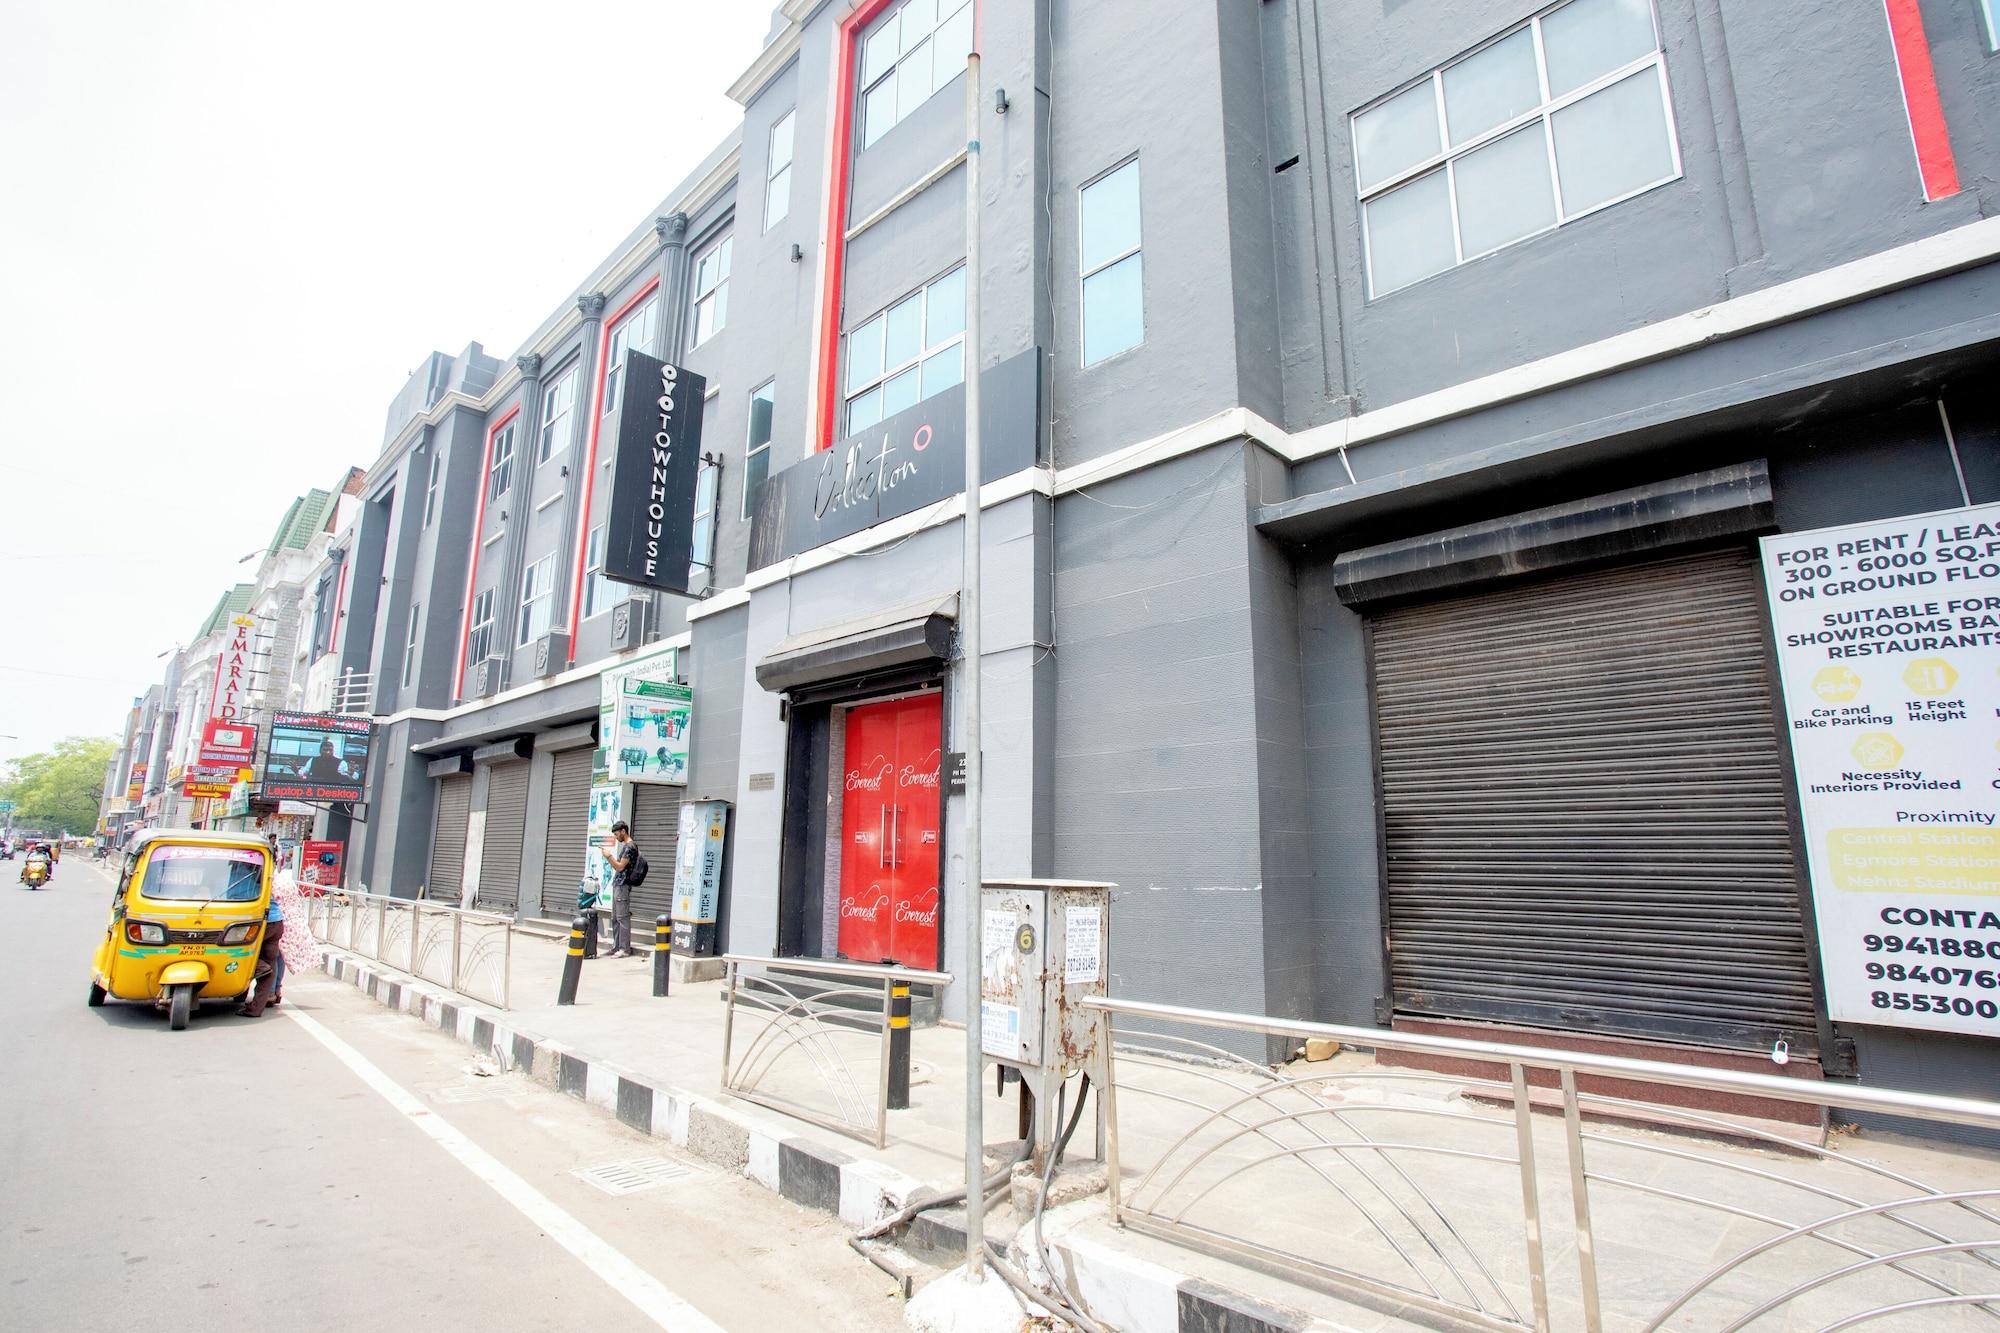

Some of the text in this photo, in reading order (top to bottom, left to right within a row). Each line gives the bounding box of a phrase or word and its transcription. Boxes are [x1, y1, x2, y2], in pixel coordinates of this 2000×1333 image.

[645, 364, 678, 577] OYO TOWNHOUSE
[814, 433, 917, 520] Collection
[1776, 546, 1829, 566] FOR
[1837, 534, 1909, 558] RENT
[1918, 528, 1928, 548] /
[1785, 564, 1832, 583] 300
[1857, 551, 1927, 572] 6000
[1779, 563, 2000, 602] ON GROUND FLO
[1823, 597, 2000, 627] SUITABLE FOR
[1787, 614, 2000, 647] SHOWROOMS BA
[221, 626, 248, 718] EMARALD
[1811, 704, 1871, 718] Car and
[1906, 699, 1966, 711] 15 Feet
[1909, 710, 1967, 722] Height
[1794, 714, 1893, 729] Bike Parking
[846, 764, 893, 791] Everest
[900, 764, 941, 788] Everest
[1811, 779, 1961, 793] Interiors Provided
[1842, 769, 1922, 782] Necessity
[267, 785, 358, 800] Laptop & Desktop
[1896, 810, 1996, 826] Proximity
[1842, 832, 1994, 846] Central Station
[1843, 853, 1920, 868] Egmore
[1847, 875, 1909, 888] Nehru
[841, 895, 889, 918] Everest
[896, 900, 938, 922] Everest
[1880, 907, 2000, 930] CONTA
[1020, 929, 1032, 949] 6
[1865, 962, 2000, 989] 984076
[1871, 991, 1999, 1019] 855300
